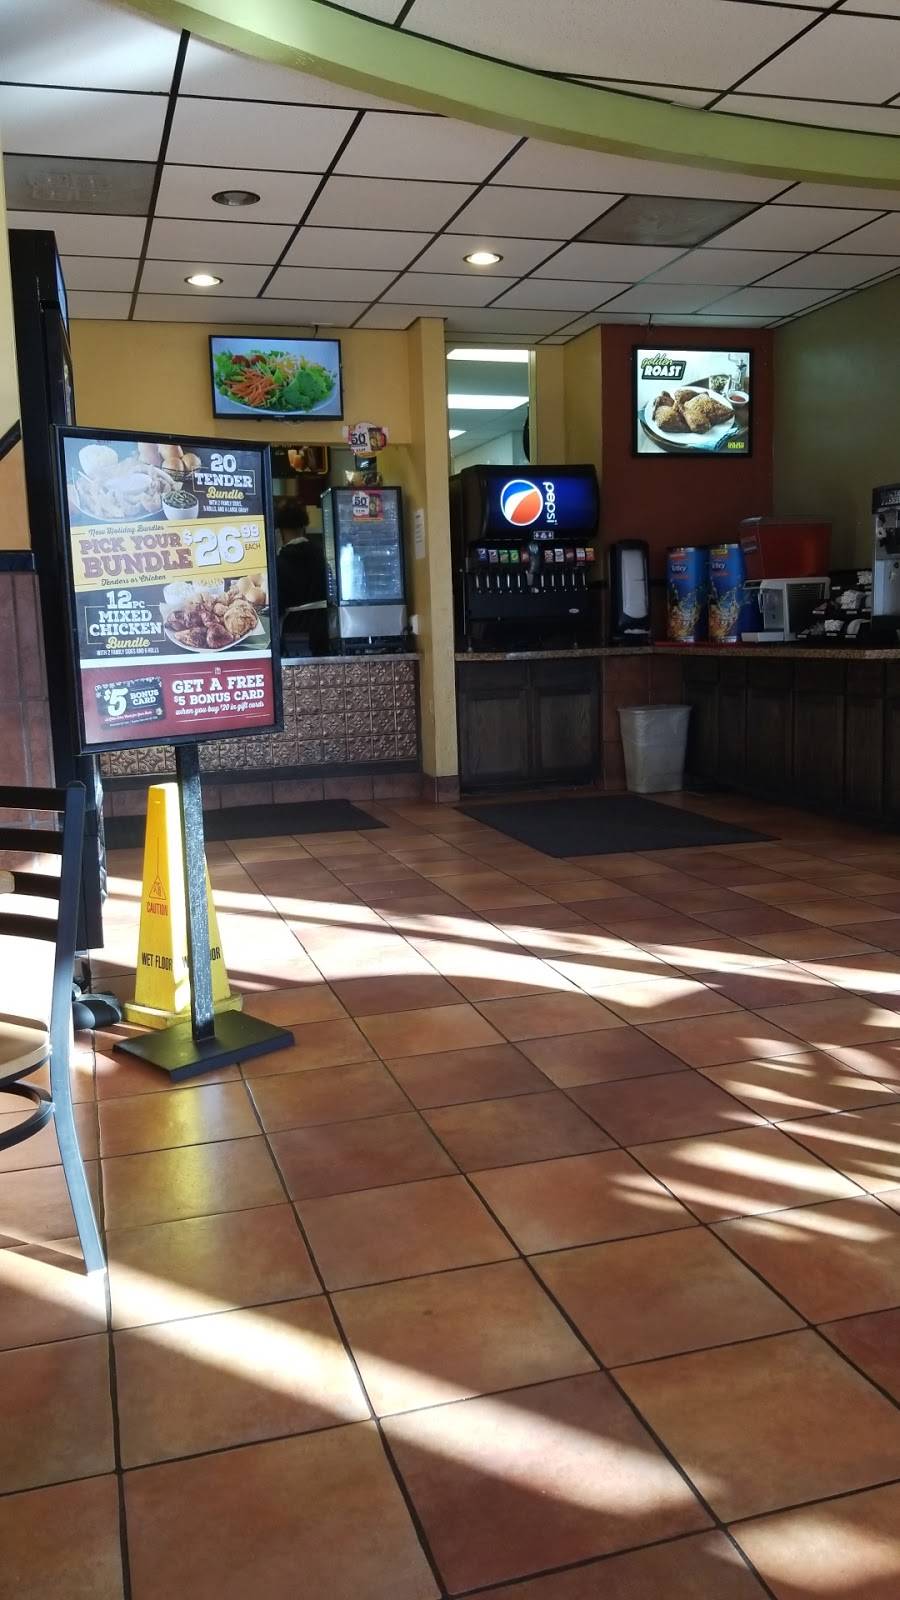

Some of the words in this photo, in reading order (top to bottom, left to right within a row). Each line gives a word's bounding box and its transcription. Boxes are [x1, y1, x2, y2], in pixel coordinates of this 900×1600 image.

[641, 353, 673, 369] golden
[644, 365, 682, 377] ROAST
[210, 453, 237, 473] 20
[195, 473, 253, 488] TENDER
[206, 486, 245, 500] Bundle
[542, 481, 557, 523] pepsi
[79, 537, 126, 555] PICK
[130, 532, 182, 550] YOUR
[244, 543, 261, 551] EACH
[81, 548, 193, 578] BUNDLE
[101, 578, 129, 586] Tenders
[139, 575, 166, 583] Chicken
[98, 609, 152, 623] MIXED
[89, 622, 162, 636] CHICKEN
[106, 636, 151, 649] Bundle
[172, 679, 204, 694] GET
[209, 677, 223, 691] A
[226, 674, 265, 690] FREE
[103, 687, 129, 717] $5
[130, 689, 159, 700] BONUS
[133, 696, 156, 706] CARD
[173, 695, 186, 706] $5
[189, 692, 231, 705] BONUS
[234, 689, 265, 701] CARD
[175, 708, 194, 716] when
[194, 707, 207, 716] you
[207, 705, 220, 715] buy
[248, 701, 265, 709] cards
[146, 901, 168, 916] CAUTION
[141, 951, 154, 967] WET
[155, 954, 173, 972] FLOOR
